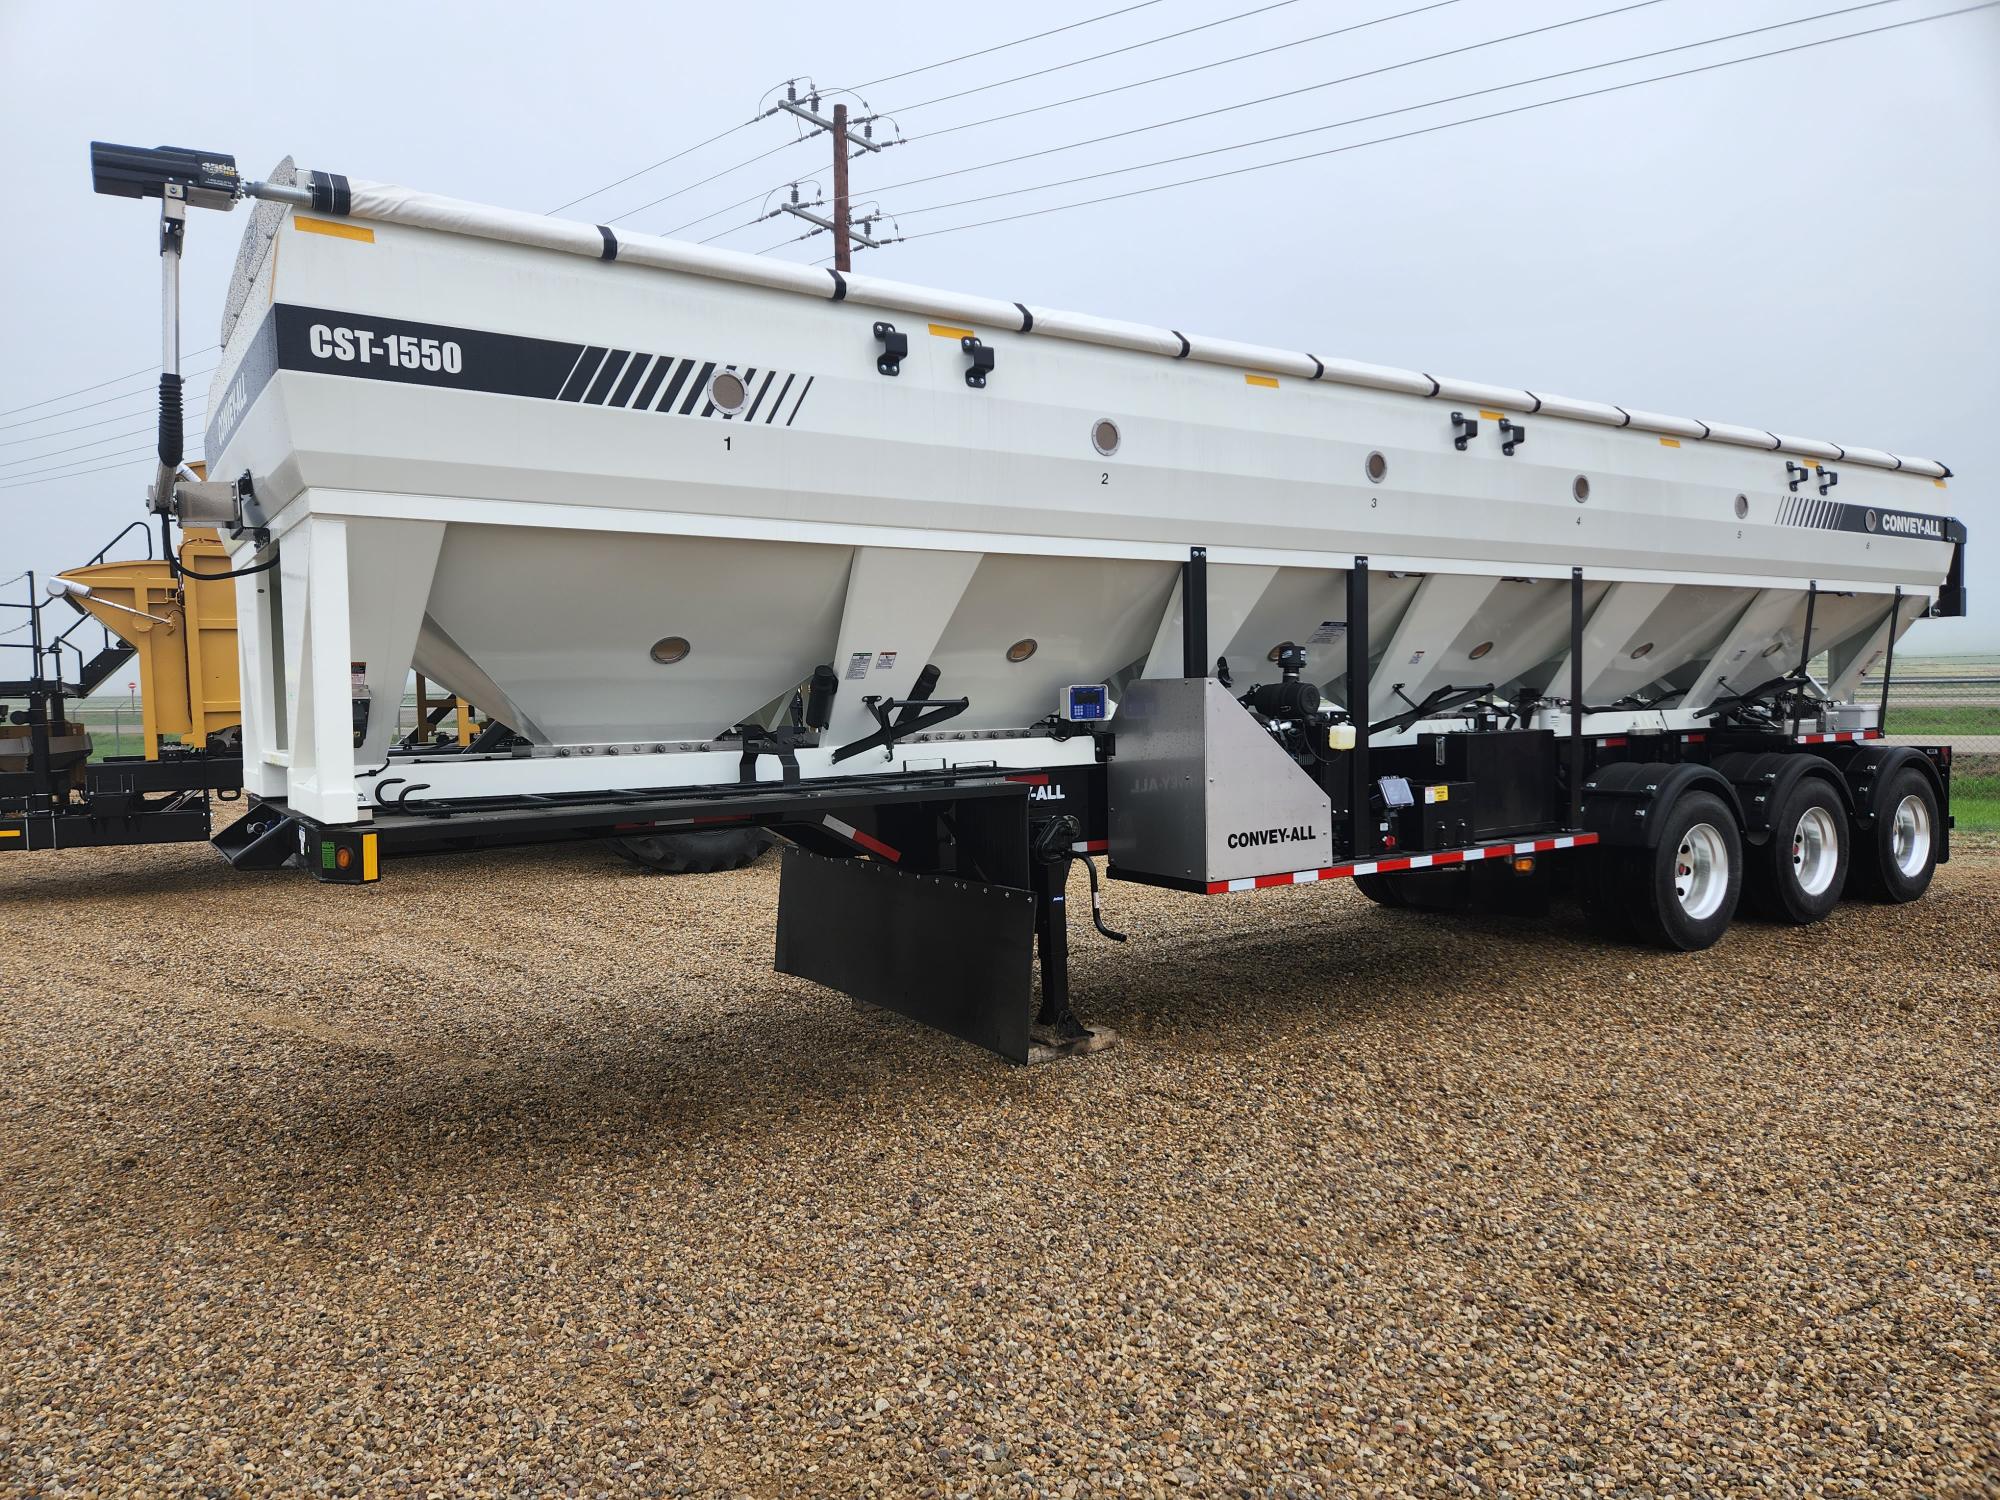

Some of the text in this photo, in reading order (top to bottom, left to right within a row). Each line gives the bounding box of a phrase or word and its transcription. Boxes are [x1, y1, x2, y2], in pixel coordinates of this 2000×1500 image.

[309, 324, 463, 374] CST-1550
[723, 436, 731, 451] 1
[1101, 472, 1109, 485] 2
[1371, 497, 1377, 509] 3
[1575, 516, 1581, 526] 4
[1882, 513, 1941, 537] CONVEY-ALL
[1227, 825, 1317, 849] CONVEY-ALL
